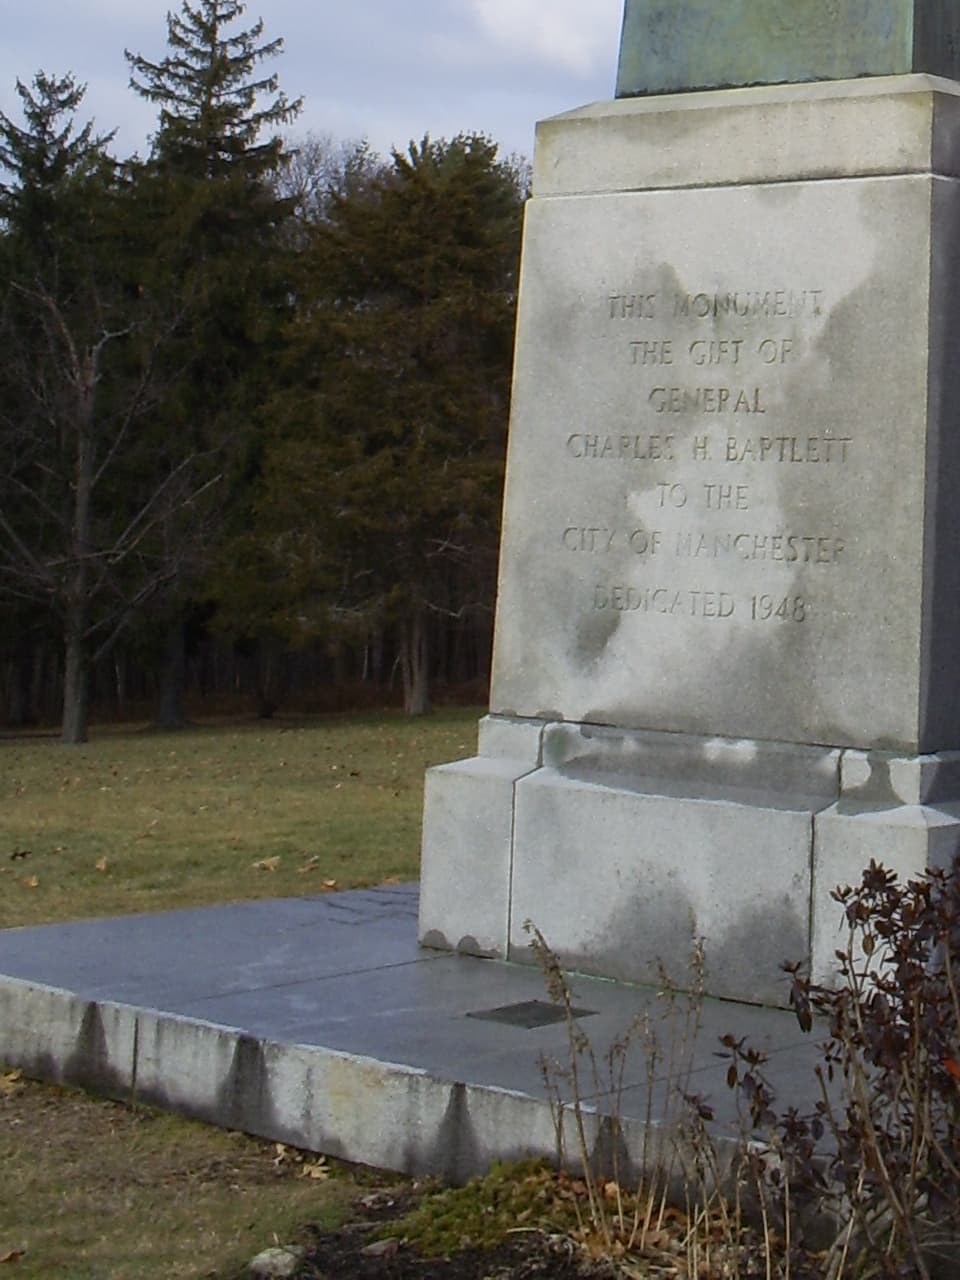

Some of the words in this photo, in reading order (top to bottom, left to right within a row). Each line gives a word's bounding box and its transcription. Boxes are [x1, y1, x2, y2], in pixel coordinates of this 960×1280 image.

[608, 292, 656, 320] THIS
[674, 288, 823, 319] MONUMENT
[630, 339, 673, 365] THE
[689, 339, 744, 366] GIFT
[759, 338, 793, 364] OF
[648, 387, 765, 414] GENERAL
[566, 433, 674, 462] CHARLES
[726, 436, 852, 464] BARTLETT
[657, 482, 688, 508] TO
[704, 483, 749, 510] THE
[562, 526, 615, 553] CITY
[629, 528, 662, 556] OF
[674, 533, 846, 564] MANCHESTER
[590, 586, 735, 619] DEDICATED
[751, 593, 806, 623] 1948
